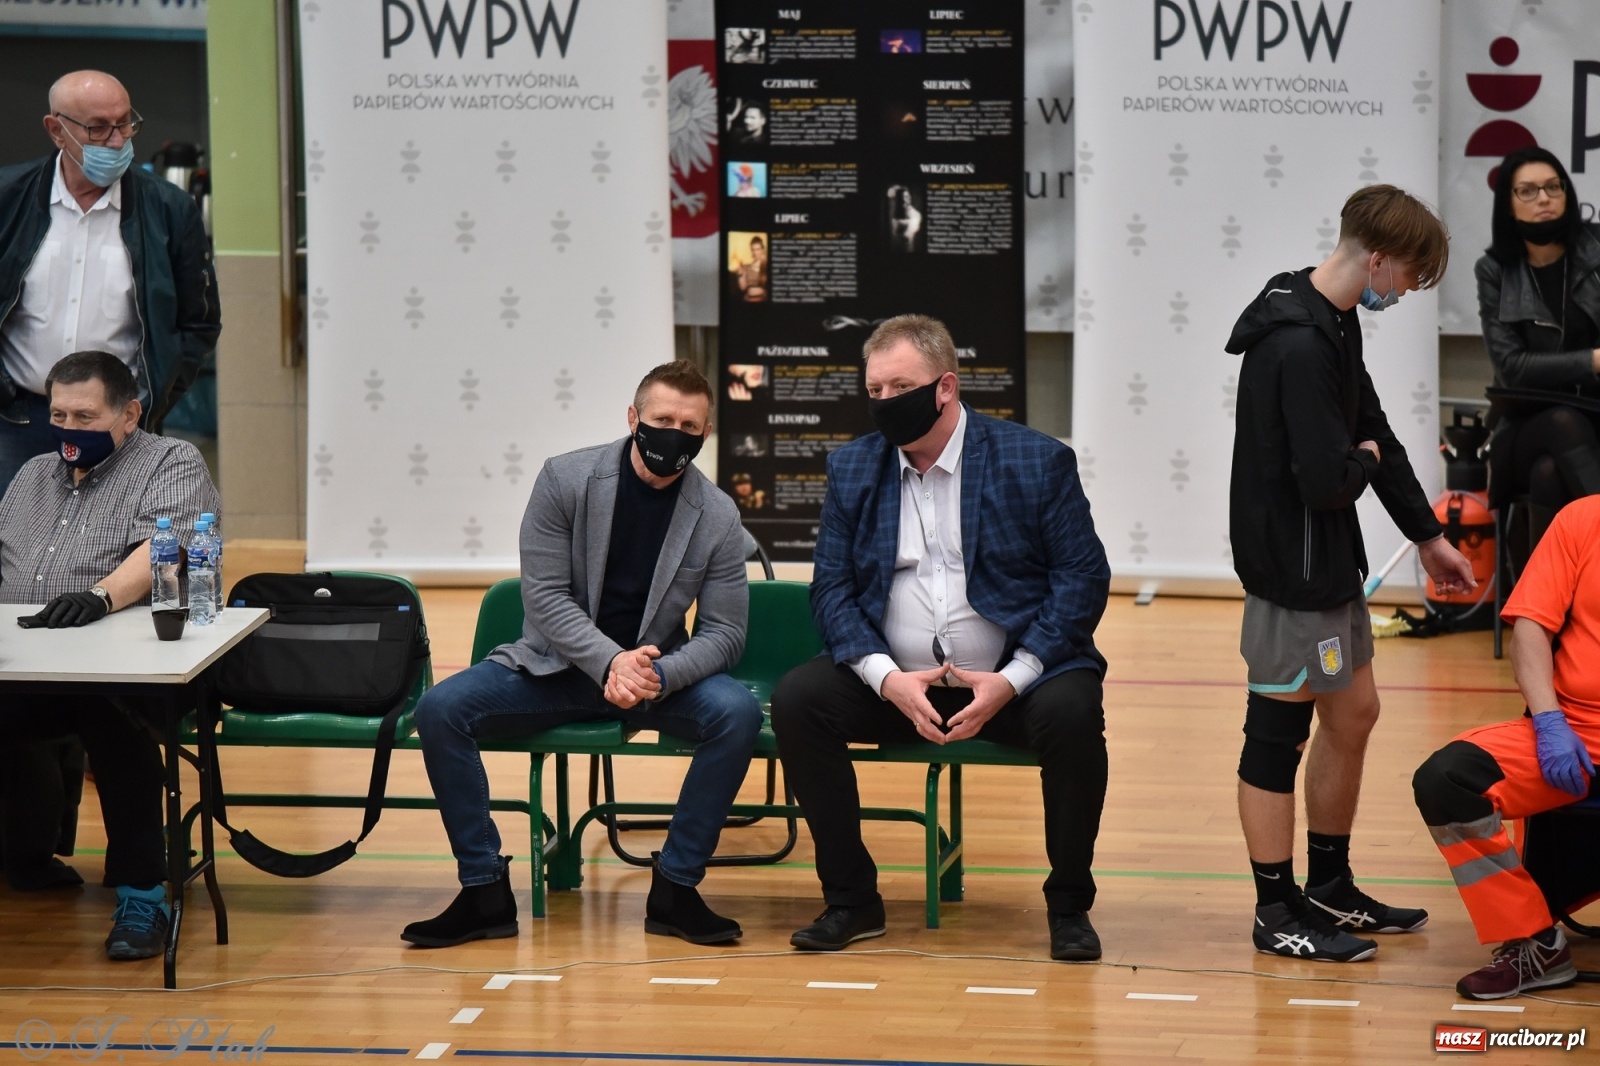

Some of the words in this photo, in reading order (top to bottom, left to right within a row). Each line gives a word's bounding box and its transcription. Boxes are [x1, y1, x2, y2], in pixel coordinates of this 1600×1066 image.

[778, 9, 801, 20] MAJ
[929, 9, 963, 20] LIPIEC
[382, 0, 581, 59] PWPW
[1153, 0, 1353, 63] PWPW
[387, 73, 458, 89] POLSKA
[461, 70, 580, 89] WYTWÓRNIA
[762, 79, 818, 90] CZERWIEC
[923, 79, 970, 90] SIERPIEŃ
[1157, 75, 1228, 93] POLSKA
[1231, 74, 1349, 94] WYTWÓRNIA
[353, 92, 446, 110] PAPIERÓW
[449, 92, 614, 111] WARTOŚCIOWYCH
[1122, 94, 1215, 113] PAPIERÓW
[1219, 95, 1383, 117] WARTOŚCIOWYCH
[920, 163, 974, 174] WRZESIEŃ
[775, 213, 809, 224] LIPIEC
[757, 344, 829, 357] PAŹDZIERNIK
[768, 414, 821, 425] LISTOPAD
[1321, 640, 1338, 651] AVFC
